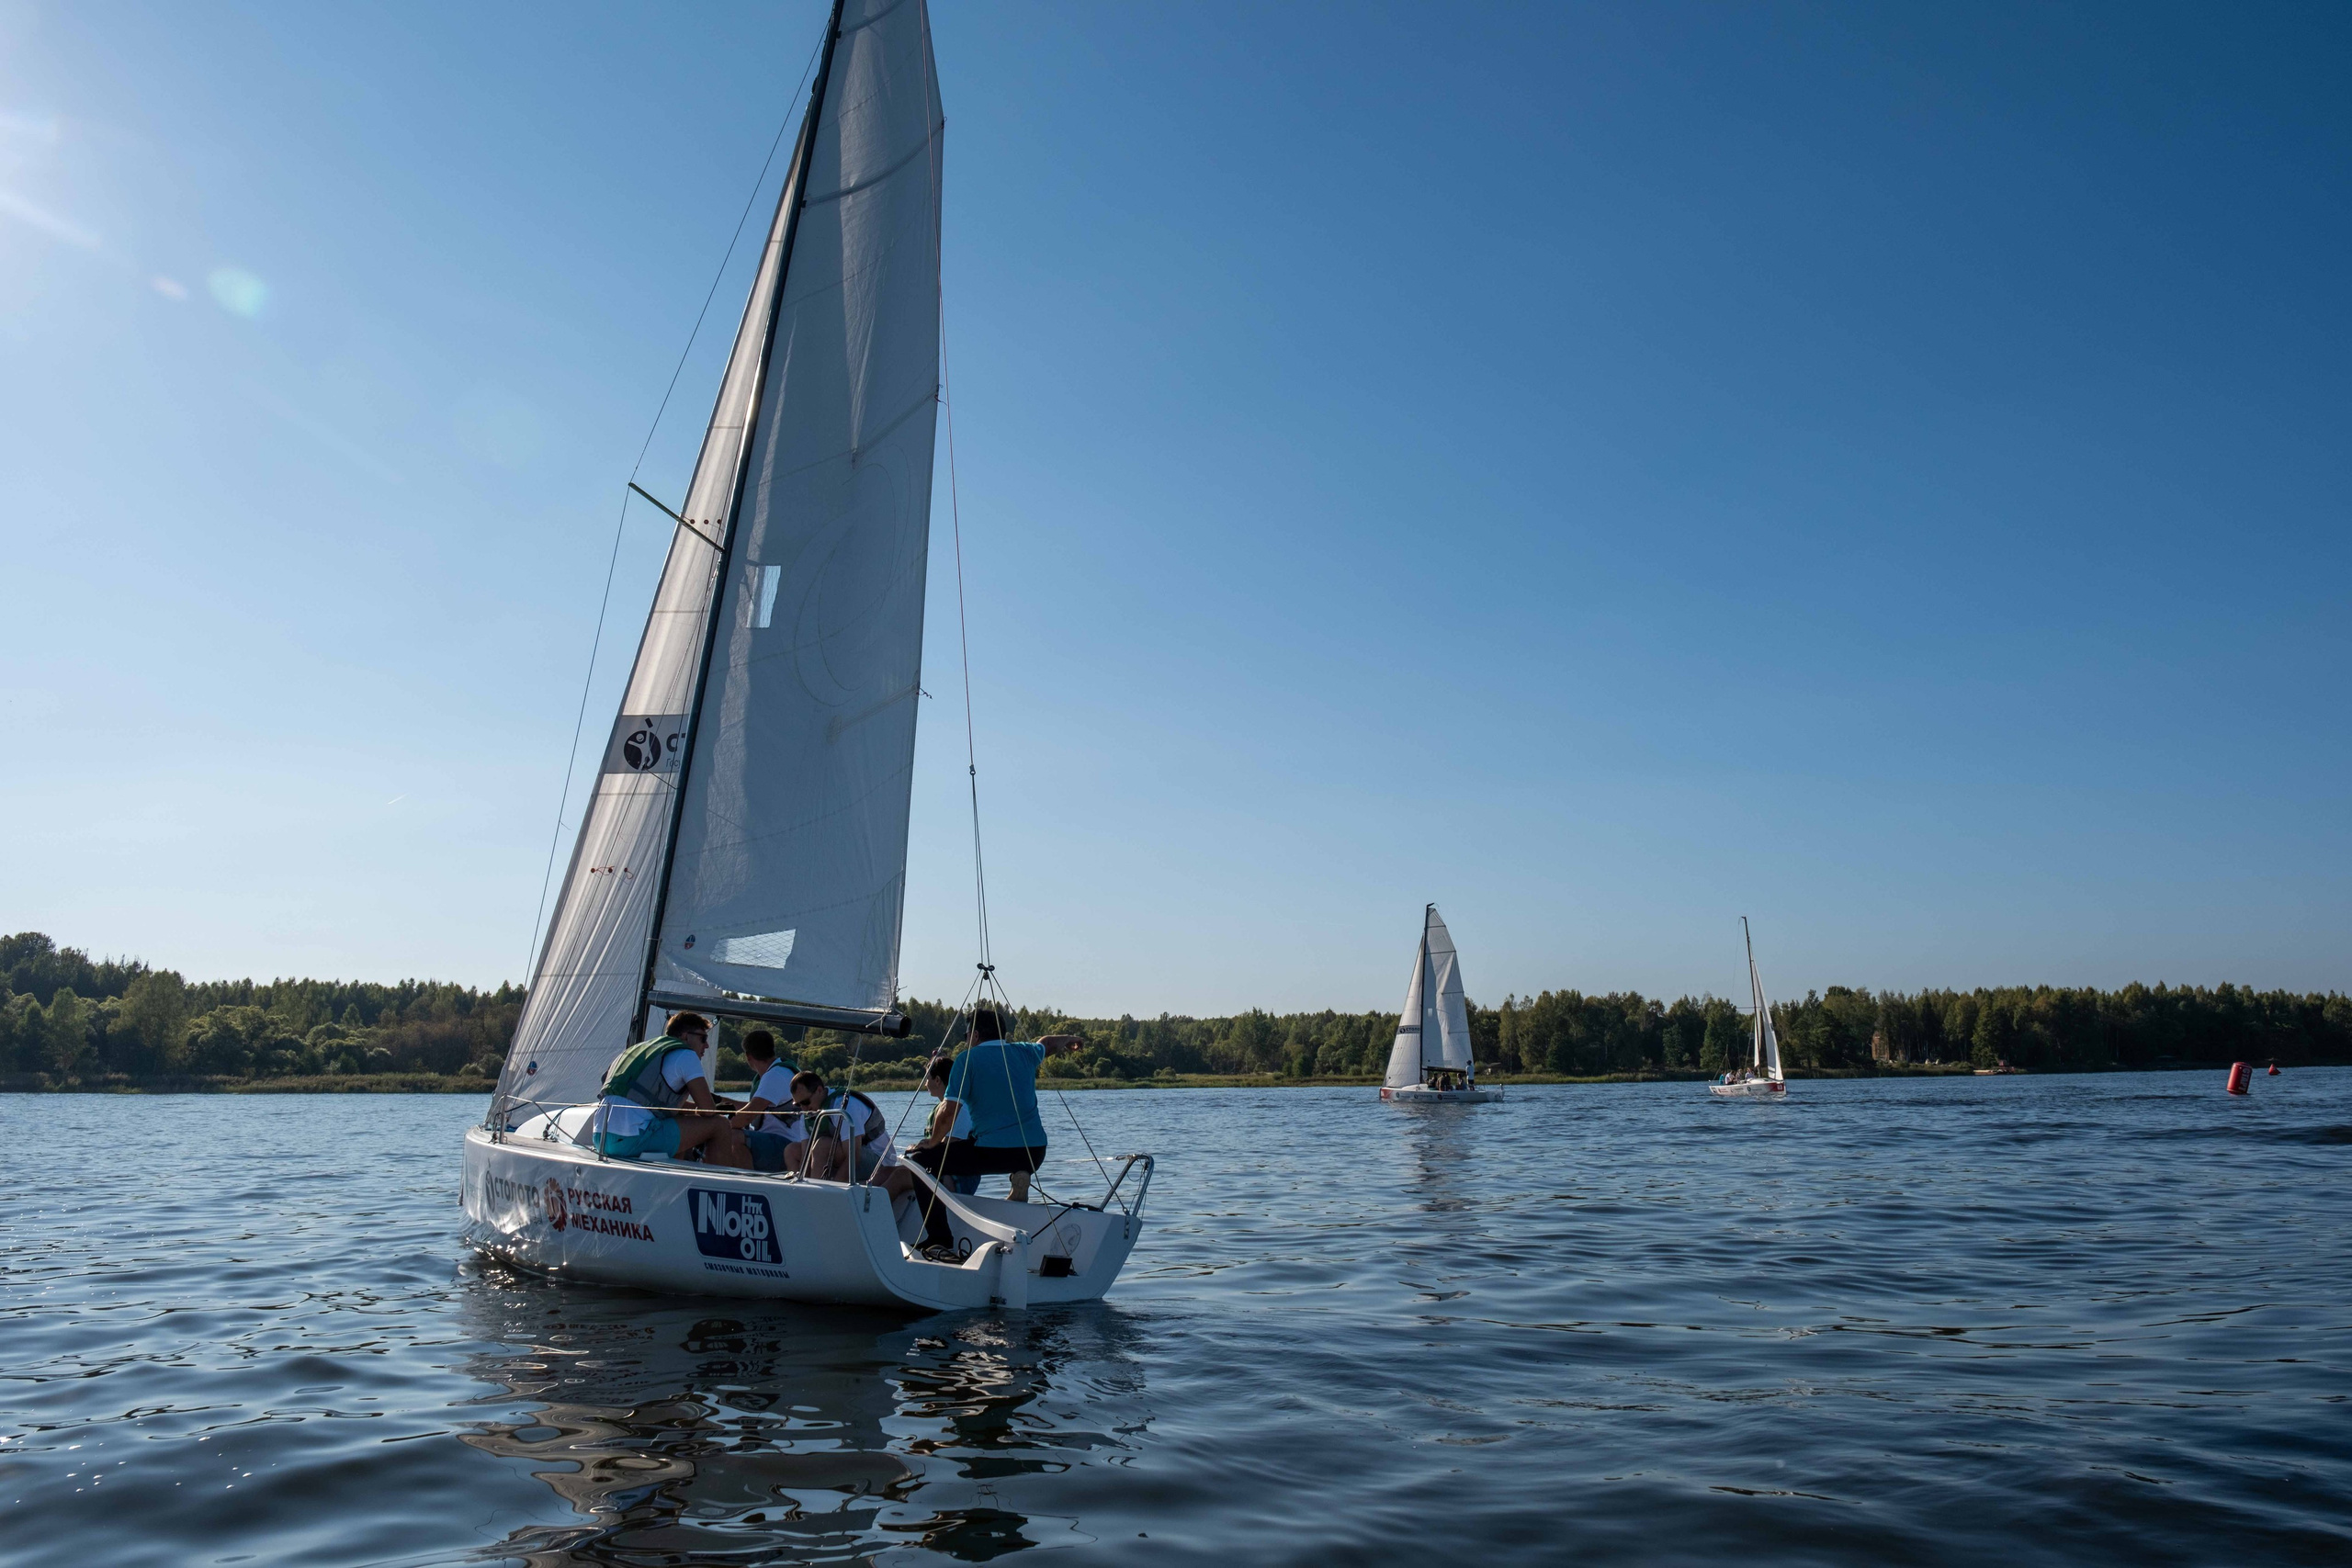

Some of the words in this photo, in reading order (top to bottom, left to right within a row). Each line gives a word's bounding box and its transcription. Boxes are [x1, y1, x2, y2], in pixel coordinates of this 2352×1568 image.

[494, 1177, 540, 1208] СТОЛОТО
[568, 1188, 632, 1214] РУССКАЯ
[571, 1213, 655, 1242] МЕХАНИКА
[740, 1237, 771, 1262] OIL
